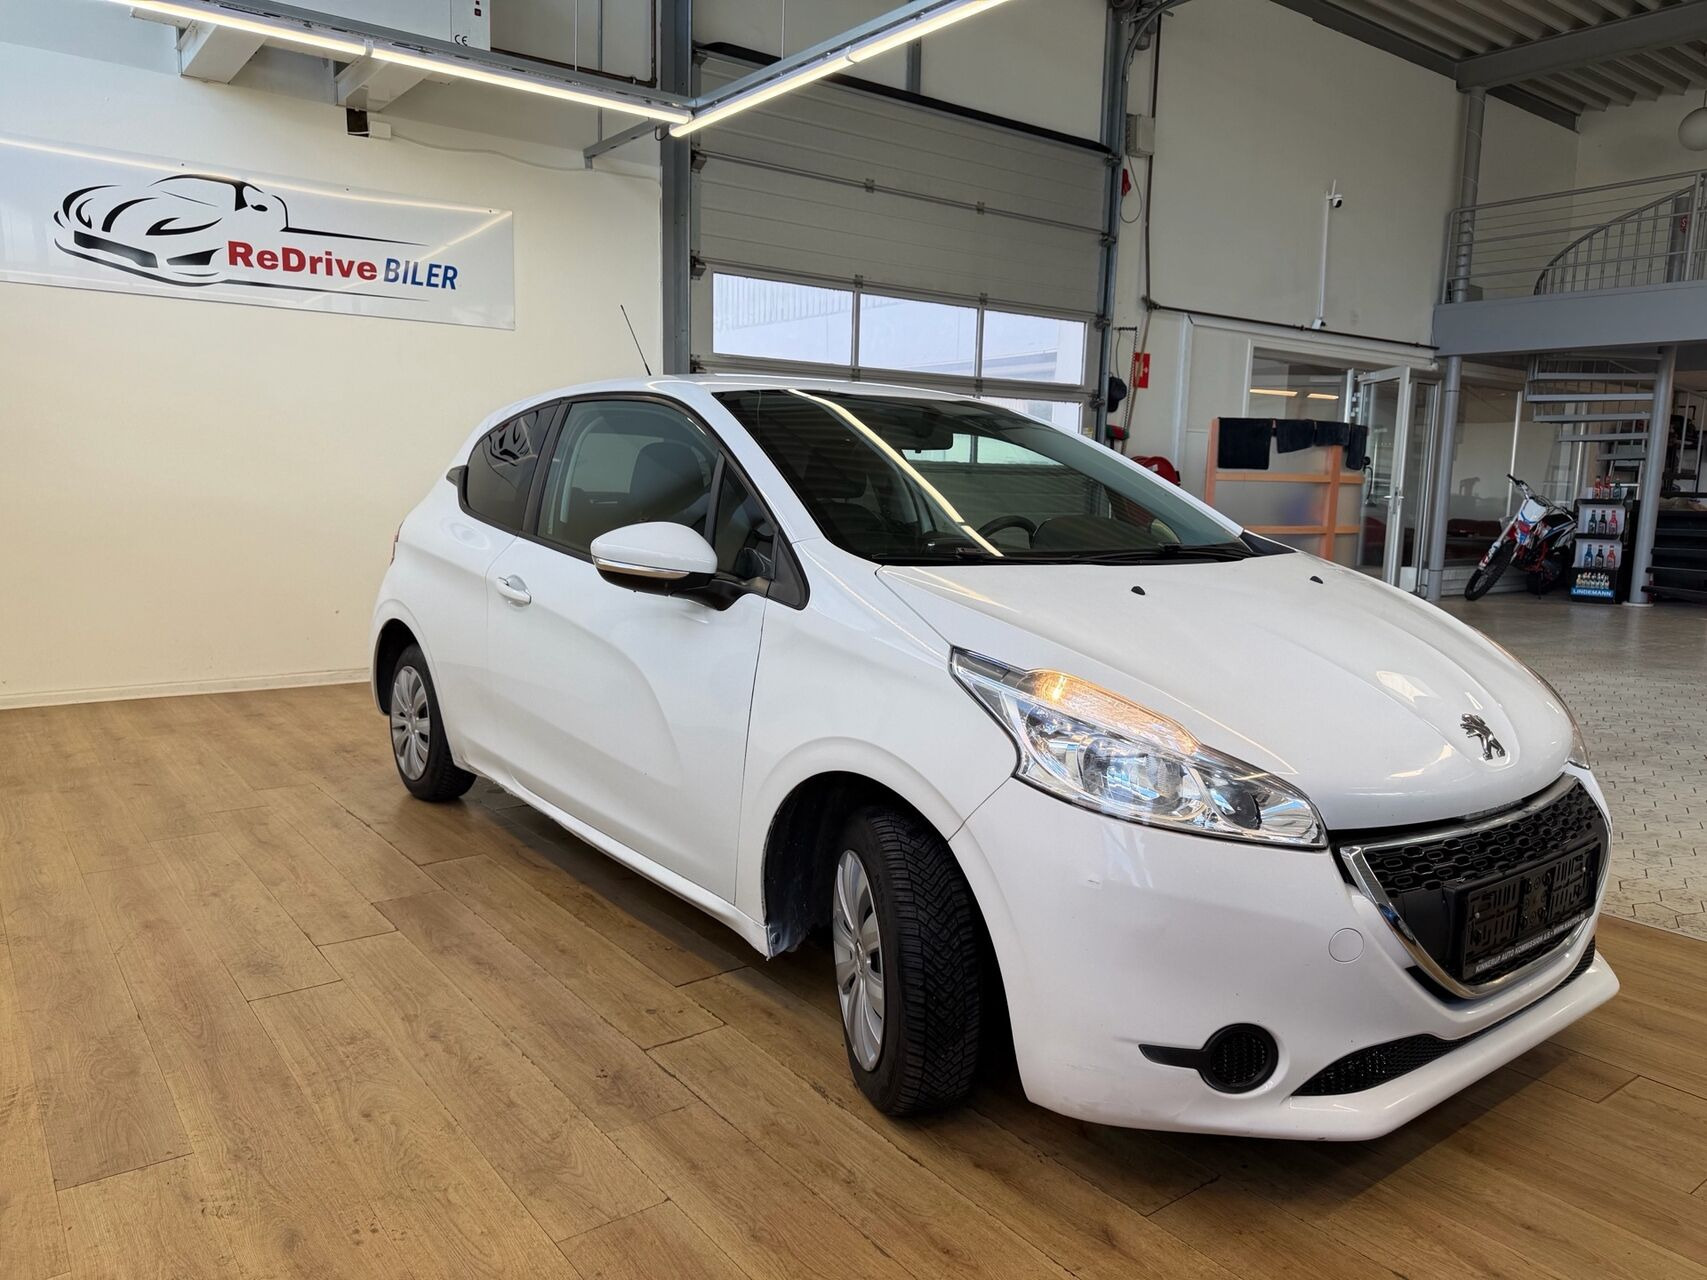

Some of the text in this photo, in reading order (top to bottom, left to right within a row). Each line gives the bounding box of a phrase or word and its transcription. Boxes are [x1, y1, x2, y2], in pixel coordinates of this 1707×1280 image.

[227, 240, 458, 290] ReDrive BILER
[1573, 588, 1612, 596] LINDEMANN
